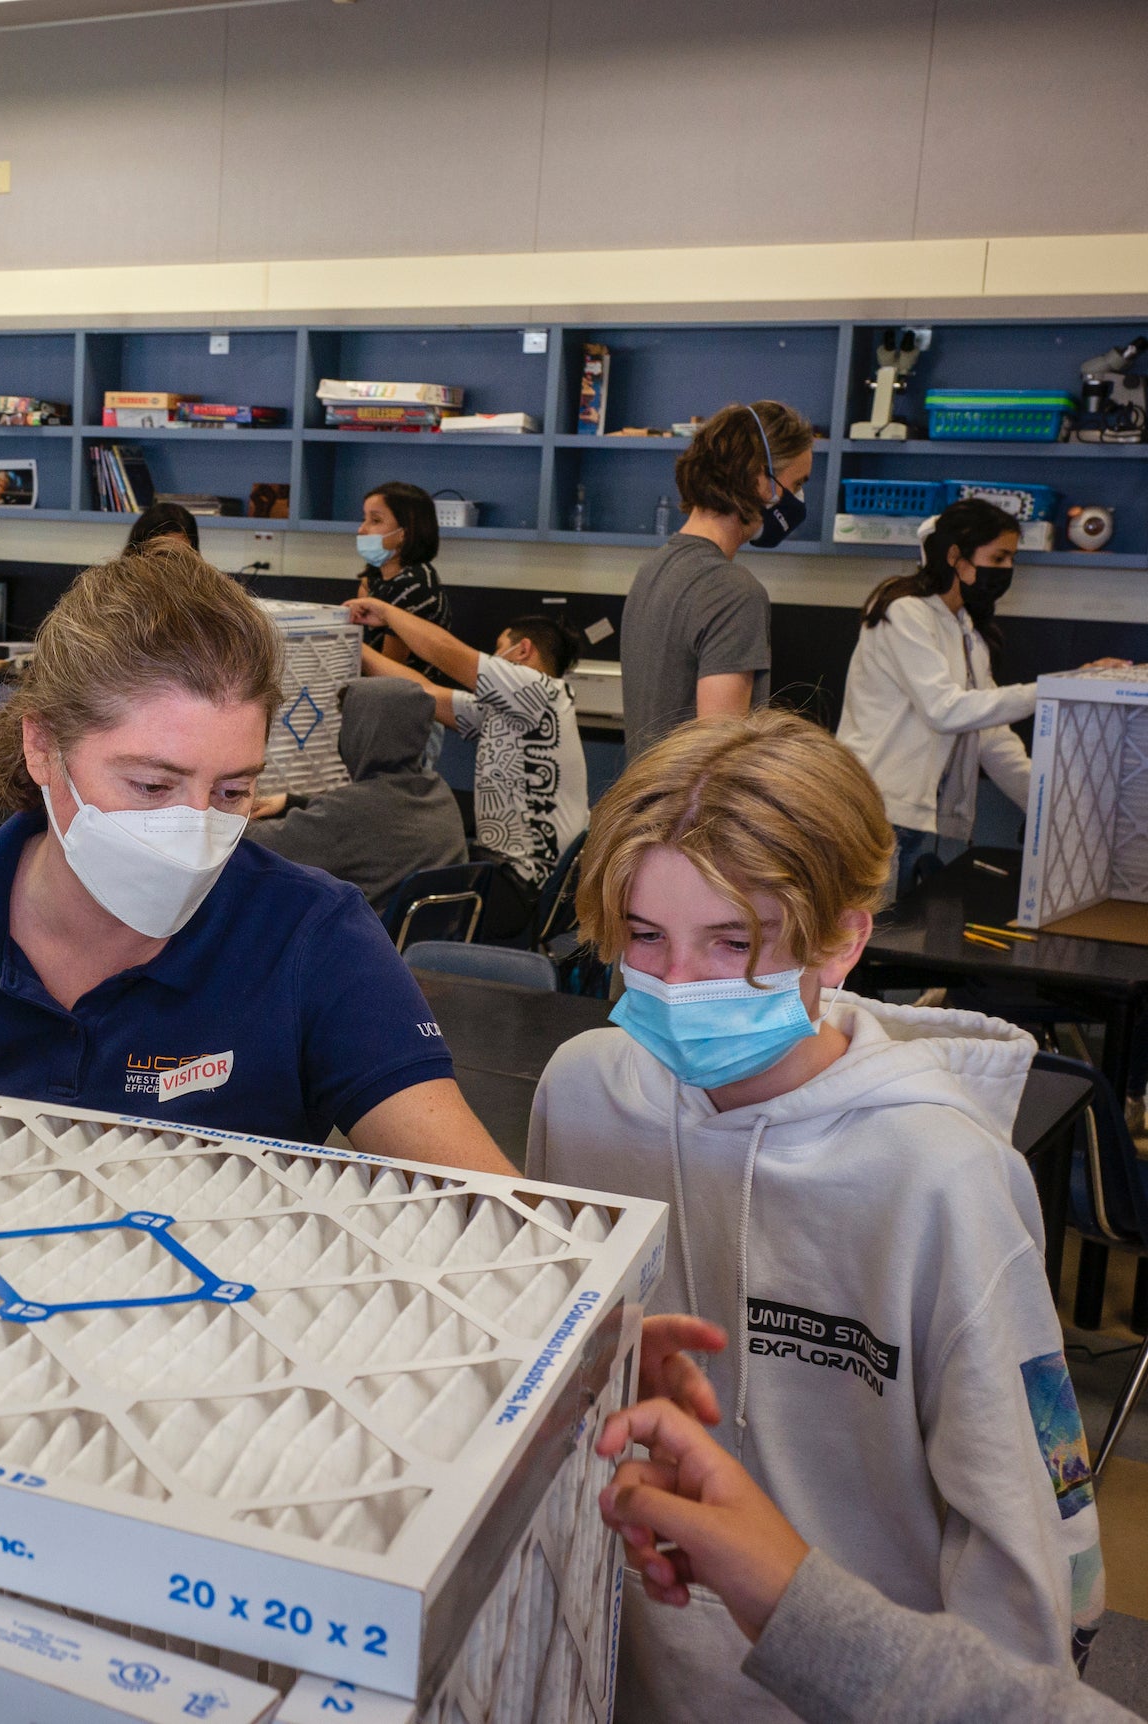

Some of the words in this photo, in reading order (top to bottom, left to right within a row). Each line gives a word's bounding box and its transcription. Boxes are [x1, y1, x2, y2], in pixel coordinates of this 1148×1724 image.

[126, 1074, 160, 1085] WESTE
[127, 1053, 213, 1071] WCE
[163, 1059, 228, 1091] VISITOR
[124, 1084, 160, 1094] EFFICIE
[119, 1116, 143, 1124] CI
[146, 1119, 245, 1142] Columbus
[246, 1137, 352, 1159] Industries,
[355, 1154, 394, 1165] Inc.
[547, 1303, 593, 1350] Columbus
[748, 1306, 826, 1338] UNITED
[834, 1325, 889, 1370] STATES
[506, 1348, 563, 1404] Industries,
[748, 1337, 884, 1397] EXPLORATION
[495, 1405, 528, 1426] Inc.
[168, 1573, 216, 1609] 20
[229, 1595, 250, 1620] x
[264, 1600, 313, 1635] 20
[327, 1621, 348, 1646] x
[363, 1625, 388, 1656] 2
